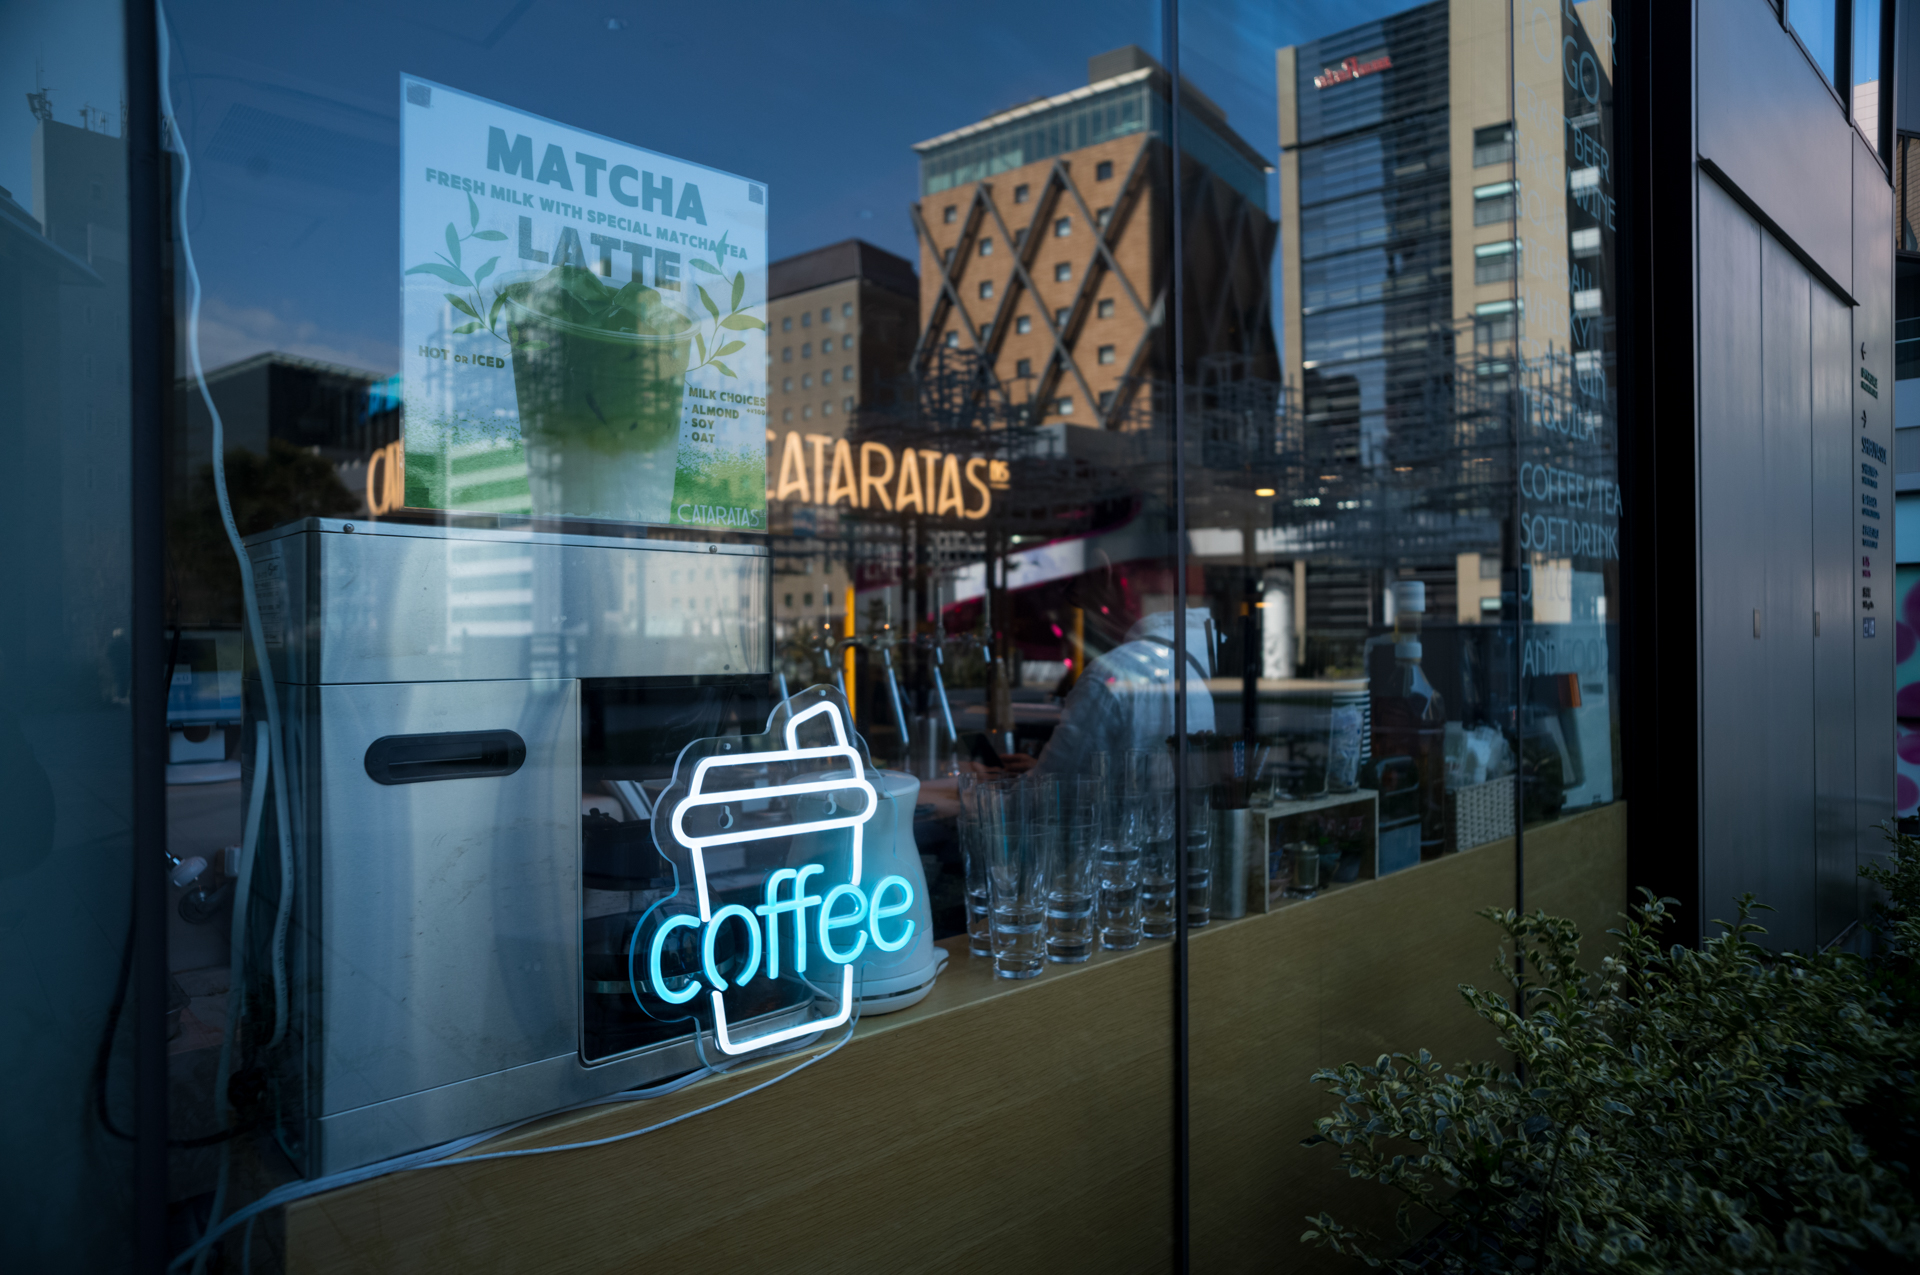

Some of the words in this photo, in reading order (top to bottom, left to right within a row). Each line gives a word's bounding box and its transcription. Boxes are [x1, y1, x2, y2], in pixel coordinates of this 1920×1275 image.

[1562, 34, 1600, 105] GO
[1515, 80, 1571, 151] CRAFT
[1574, 128, 1610, 184] BEER
[486, 125, 708, 226] MATCHA
[1515, 130, 1561, 192] SAKE
[1575, 184, 1616, 233] WINE
[426, 167, 486, 196] FRESH
[490, 184, 535, 209] MILK
[539, 196, 583, 220] WITH
[587, 209, 652, 238] SPECIAL
[656, 226, 717, 253] MATCHA
[720, 242, 748, 260] TEA
[518, 215, 681, 292] LATTE
[418, 345, 450, 361] HOT
[454, 354, 468, 364] OR
[472, 353, 505, 369] ICED
[688, 386, 717, 401] MILK
[719, 391, 766, 407] CHOICES
[691, 404, 740, 420] ALMOND
[691, 418, 715, 430] SOY
[1518, 384, 1597, 445] TEQUILA
[691, 431, 715, 444] OAT
[677, 503, 760, 527] CATARATAS
[1520, 511, 1569, 555] SOFT
[1571, 519, 1619, 561] DRINK
[1521, 638, 1559, 678] AND
[650, 864, 916, 1004] coffee
